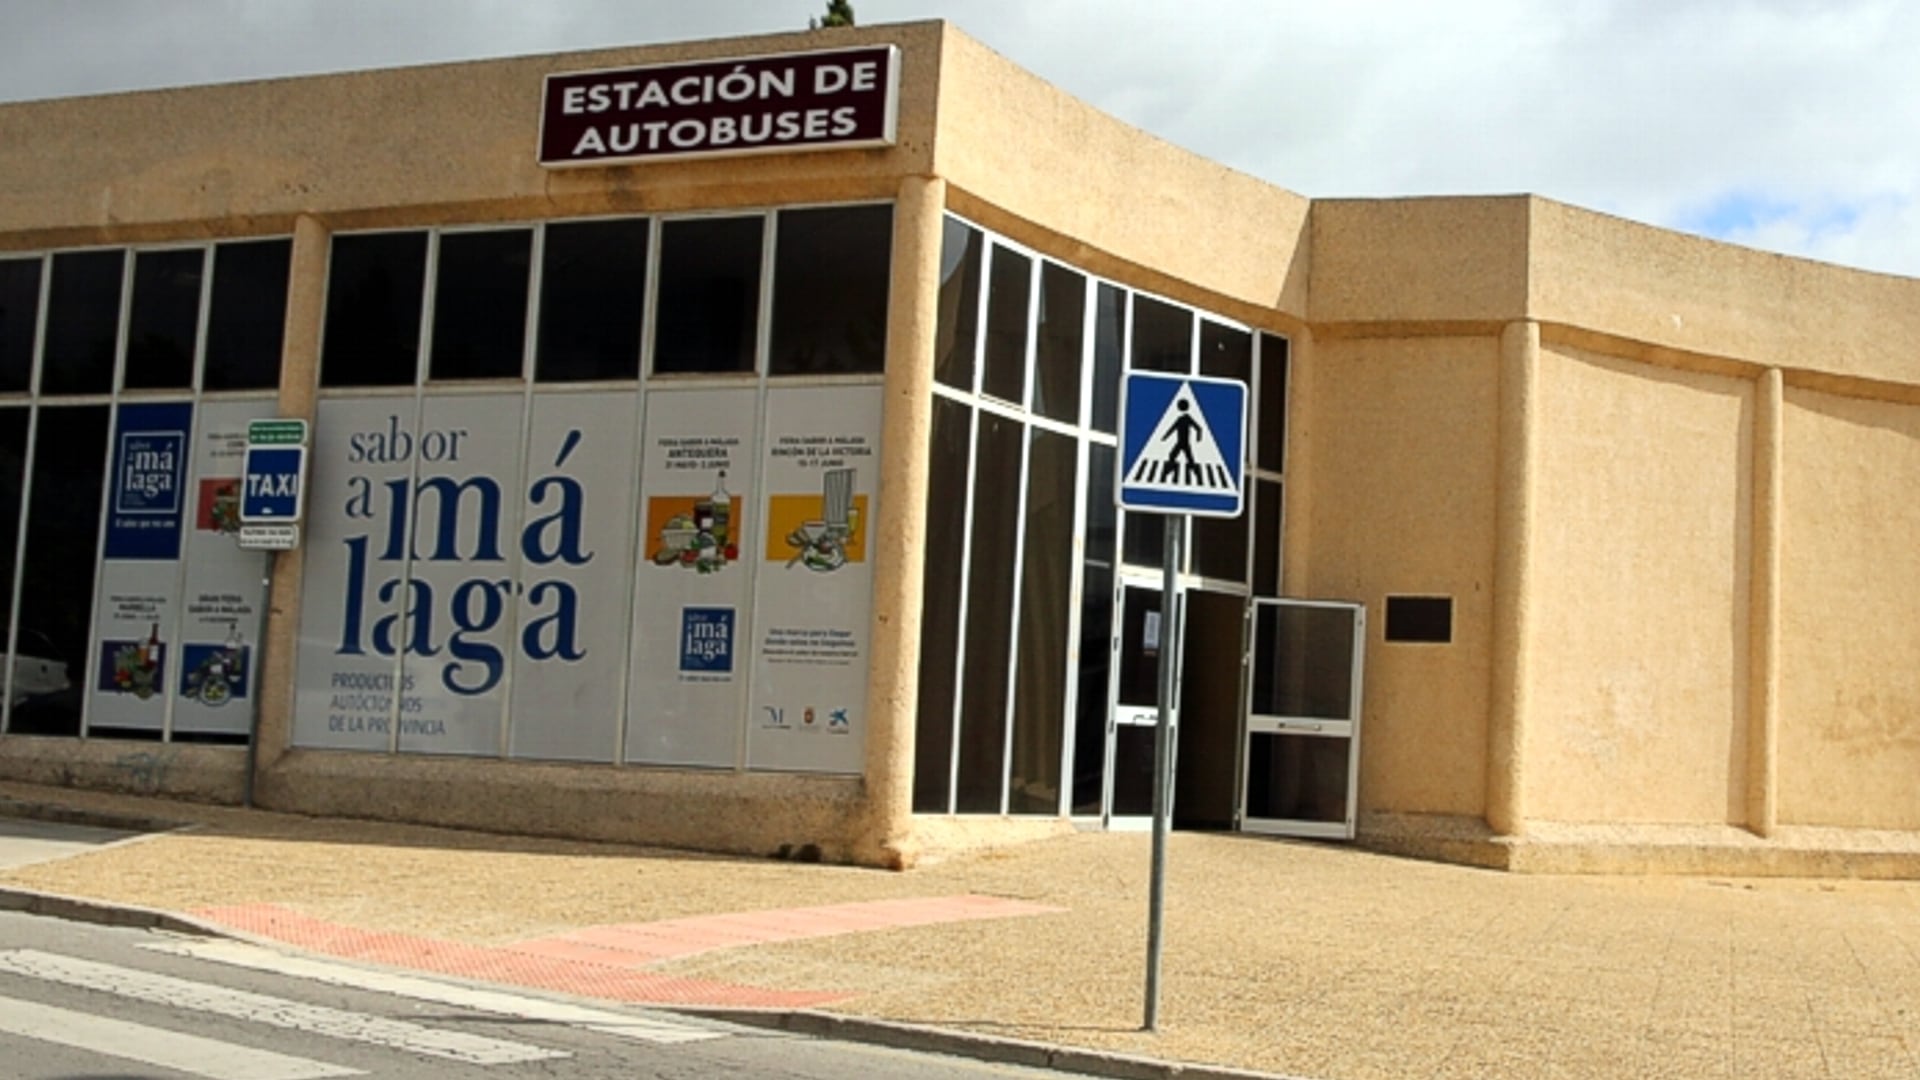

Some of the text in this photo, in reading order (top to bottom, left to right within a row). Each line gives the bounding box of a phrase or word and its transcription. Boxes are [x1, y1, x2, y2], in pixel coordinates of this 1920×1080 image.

[562, 61, 877, 115] ESTACIÓN DE
[571, 106, 858, 155] AUTOBUSES
[348, 415, 468, 464] sabor
[247, 473, 298, 498] TAXI
[345, 430, 595, 566] a má
[335, 534, 588, 696] laga
[328, 715, 345, 732] DE
[348, 715, 364, 732] LA
